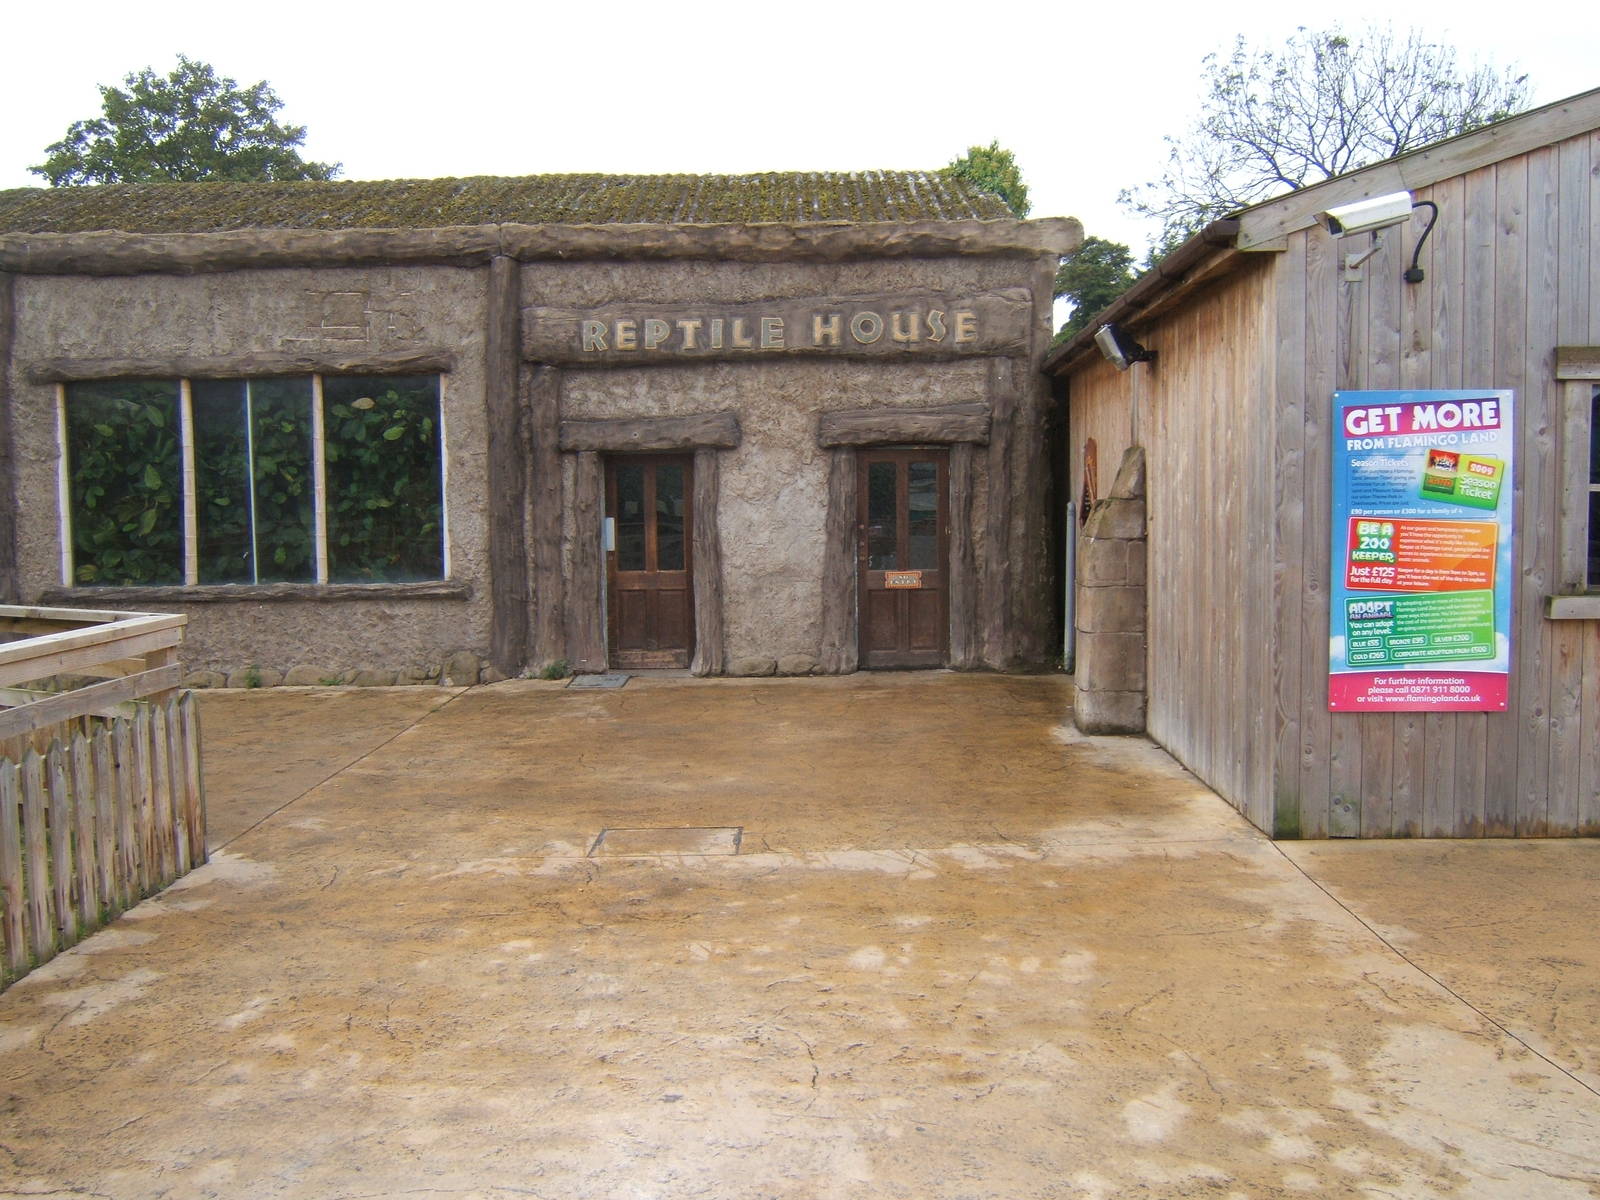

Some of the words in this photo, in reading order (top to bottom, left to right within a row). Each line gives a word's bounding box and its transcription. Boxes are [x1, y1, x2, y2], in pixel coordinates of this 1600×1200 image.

[582, 317, 786, 352] REPTILE
[812, 310, 978, 346] HOUSE
[1345, 407, 1402, 436] GET
[1412, 401, 1498, 431] MORE
[1346, 438, 1385, 451] FROM
[1388, 434, 1458, 449] FLAMINGO
[1461, 431, 1497, 445] LAND
[1351, 459, 1377, 467] Season
[1379, 458, 1409, 467] Tickets
[1460, 474, 1497, 488] Season
[1460, 485, 1494, 500] Ticket
[1358, 521, 1380, 535] BE
[1381, 522, 1394, 536] A
[1352, 550, 1394, 563] KEEPER
[1350, 566, 1371, 576] Just
[1371, 566, 1395, 577] £125
[1349, 601, 1394, 614] ADOPT
[1362, 611, 1393, 619] ANIMAL
[1375, 620, 1394, 629] adopt
[1374, 676, 1387, 685] For
[1388, 676, 1416, 685] further
[1418, 676, 1465, 685] information
[1368, 685, 1394, 695] please
[1395, 685, 1409, 694] call
[1410, 685, 1431, 694] 0871
[1432, 685, 1448, 694] 911
[1449, 685, 1471, 694] 8000
[1356, 695, 1366, 703] or
[1367, 694, 1384, 703] visit
[1385, 693, 1481, 704] www.flamingoland.co.uk
